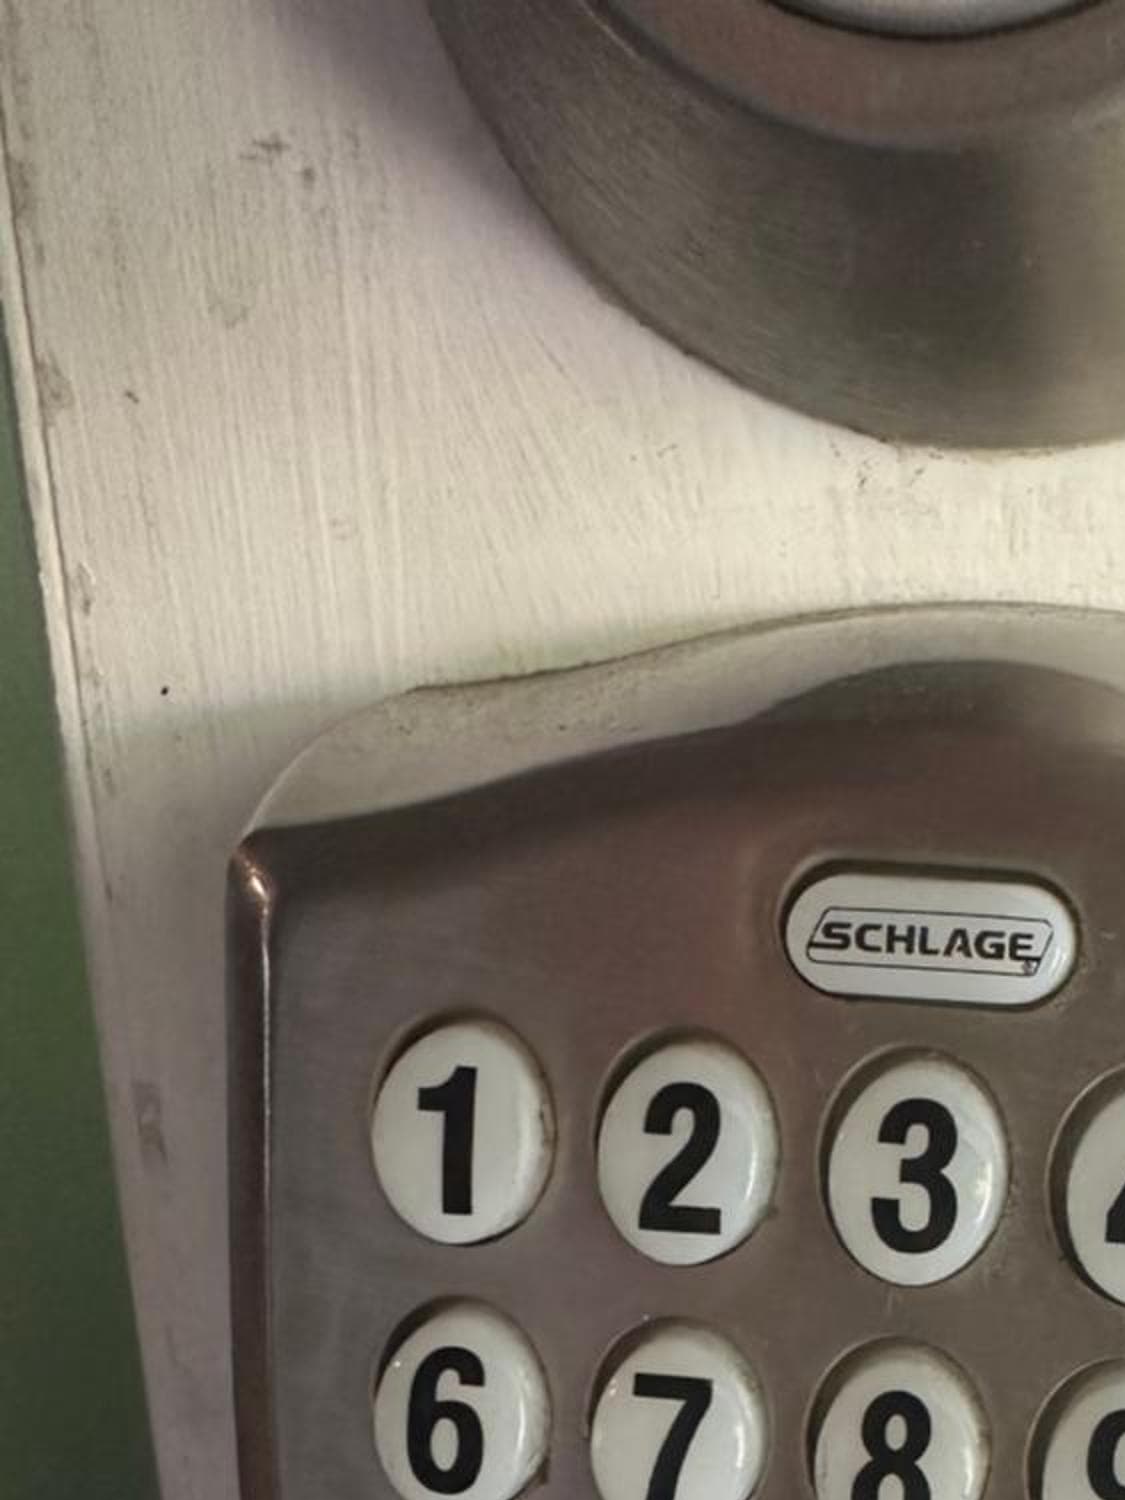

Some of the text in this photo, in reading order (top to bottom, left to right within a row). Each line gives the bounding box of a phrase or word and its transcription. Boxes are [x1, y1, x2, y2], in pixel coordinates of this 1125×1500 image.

[815, 921, 1041, 963] SCHLAGE
[417, 1066, 477, 1215] 1
[638, 1082, 721, 1234] 2
[871, 1098, 957, 1254] 3
[406, 1346, 485, 1495] 6
